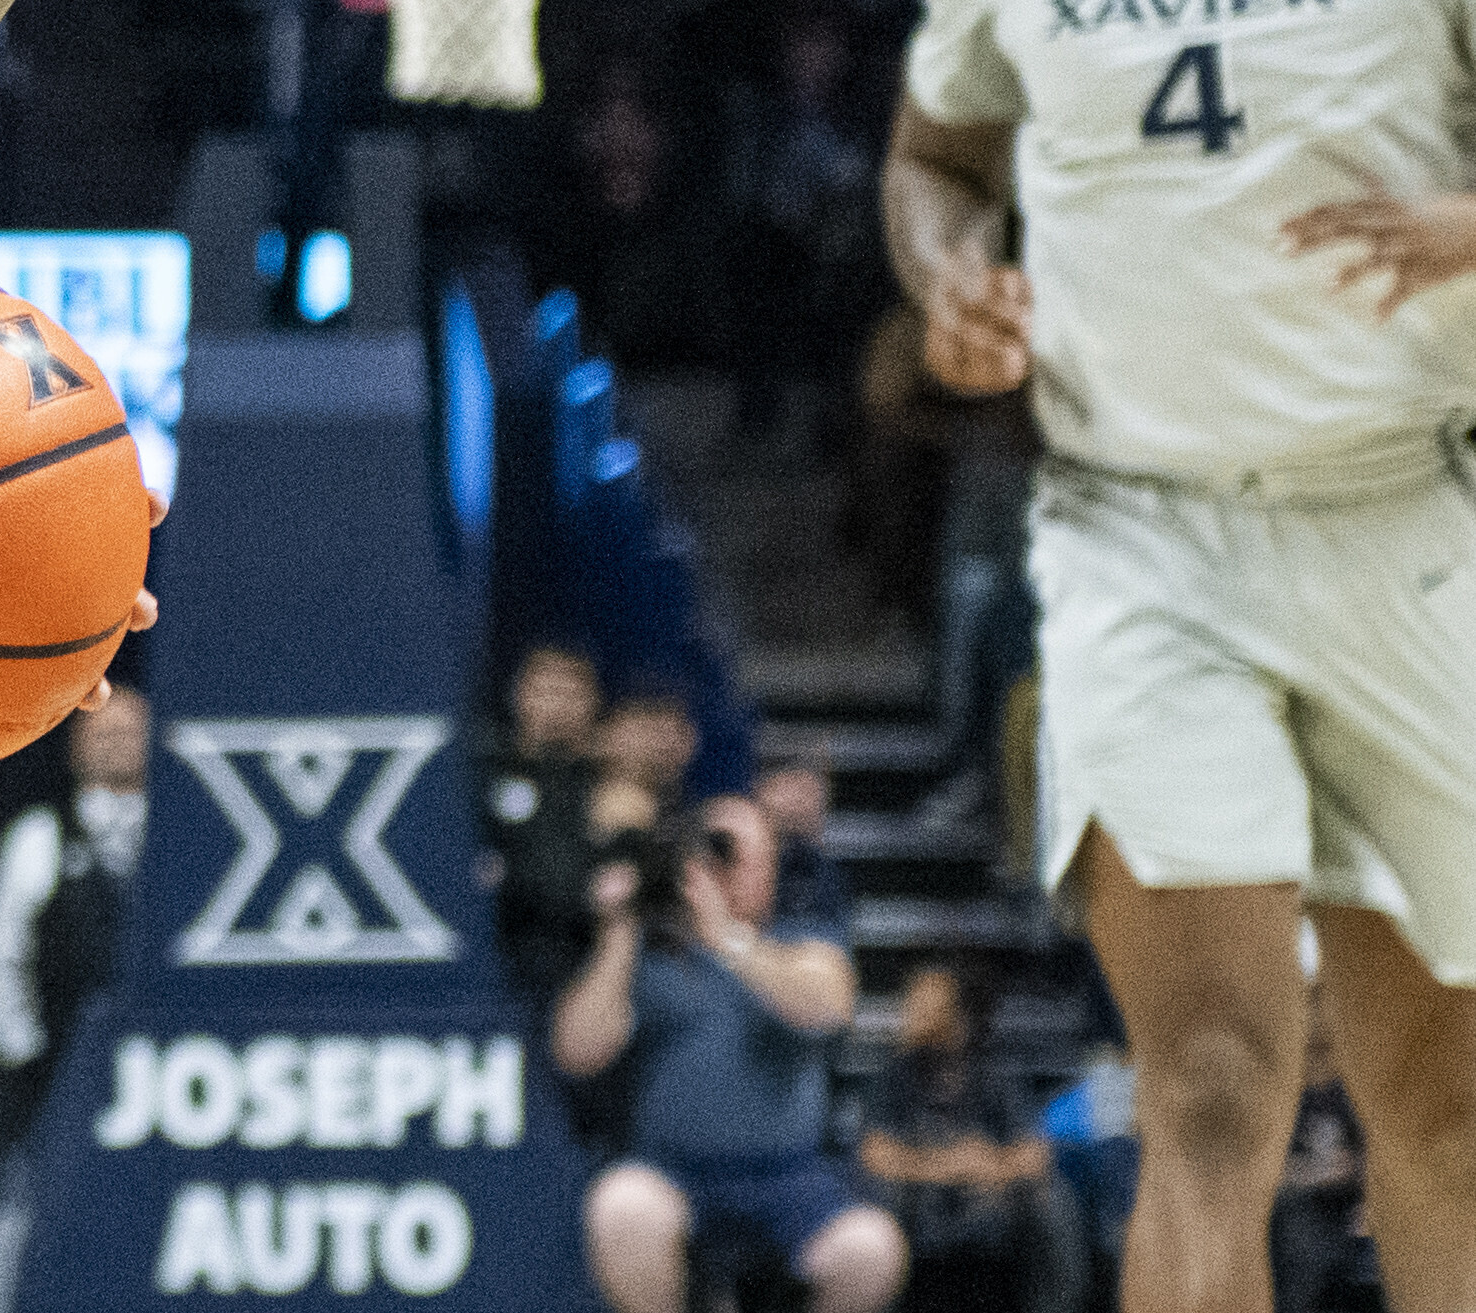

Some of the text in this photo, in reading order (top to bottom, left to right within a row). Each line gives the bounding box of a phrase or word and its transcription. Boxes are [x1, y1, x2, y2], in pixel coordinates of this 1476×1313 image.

[1141, 42, 1248, 158] 4
[93, 1032, 528, 1150] JOSEPH
[152, 1179, 474, 1296] AUTO
